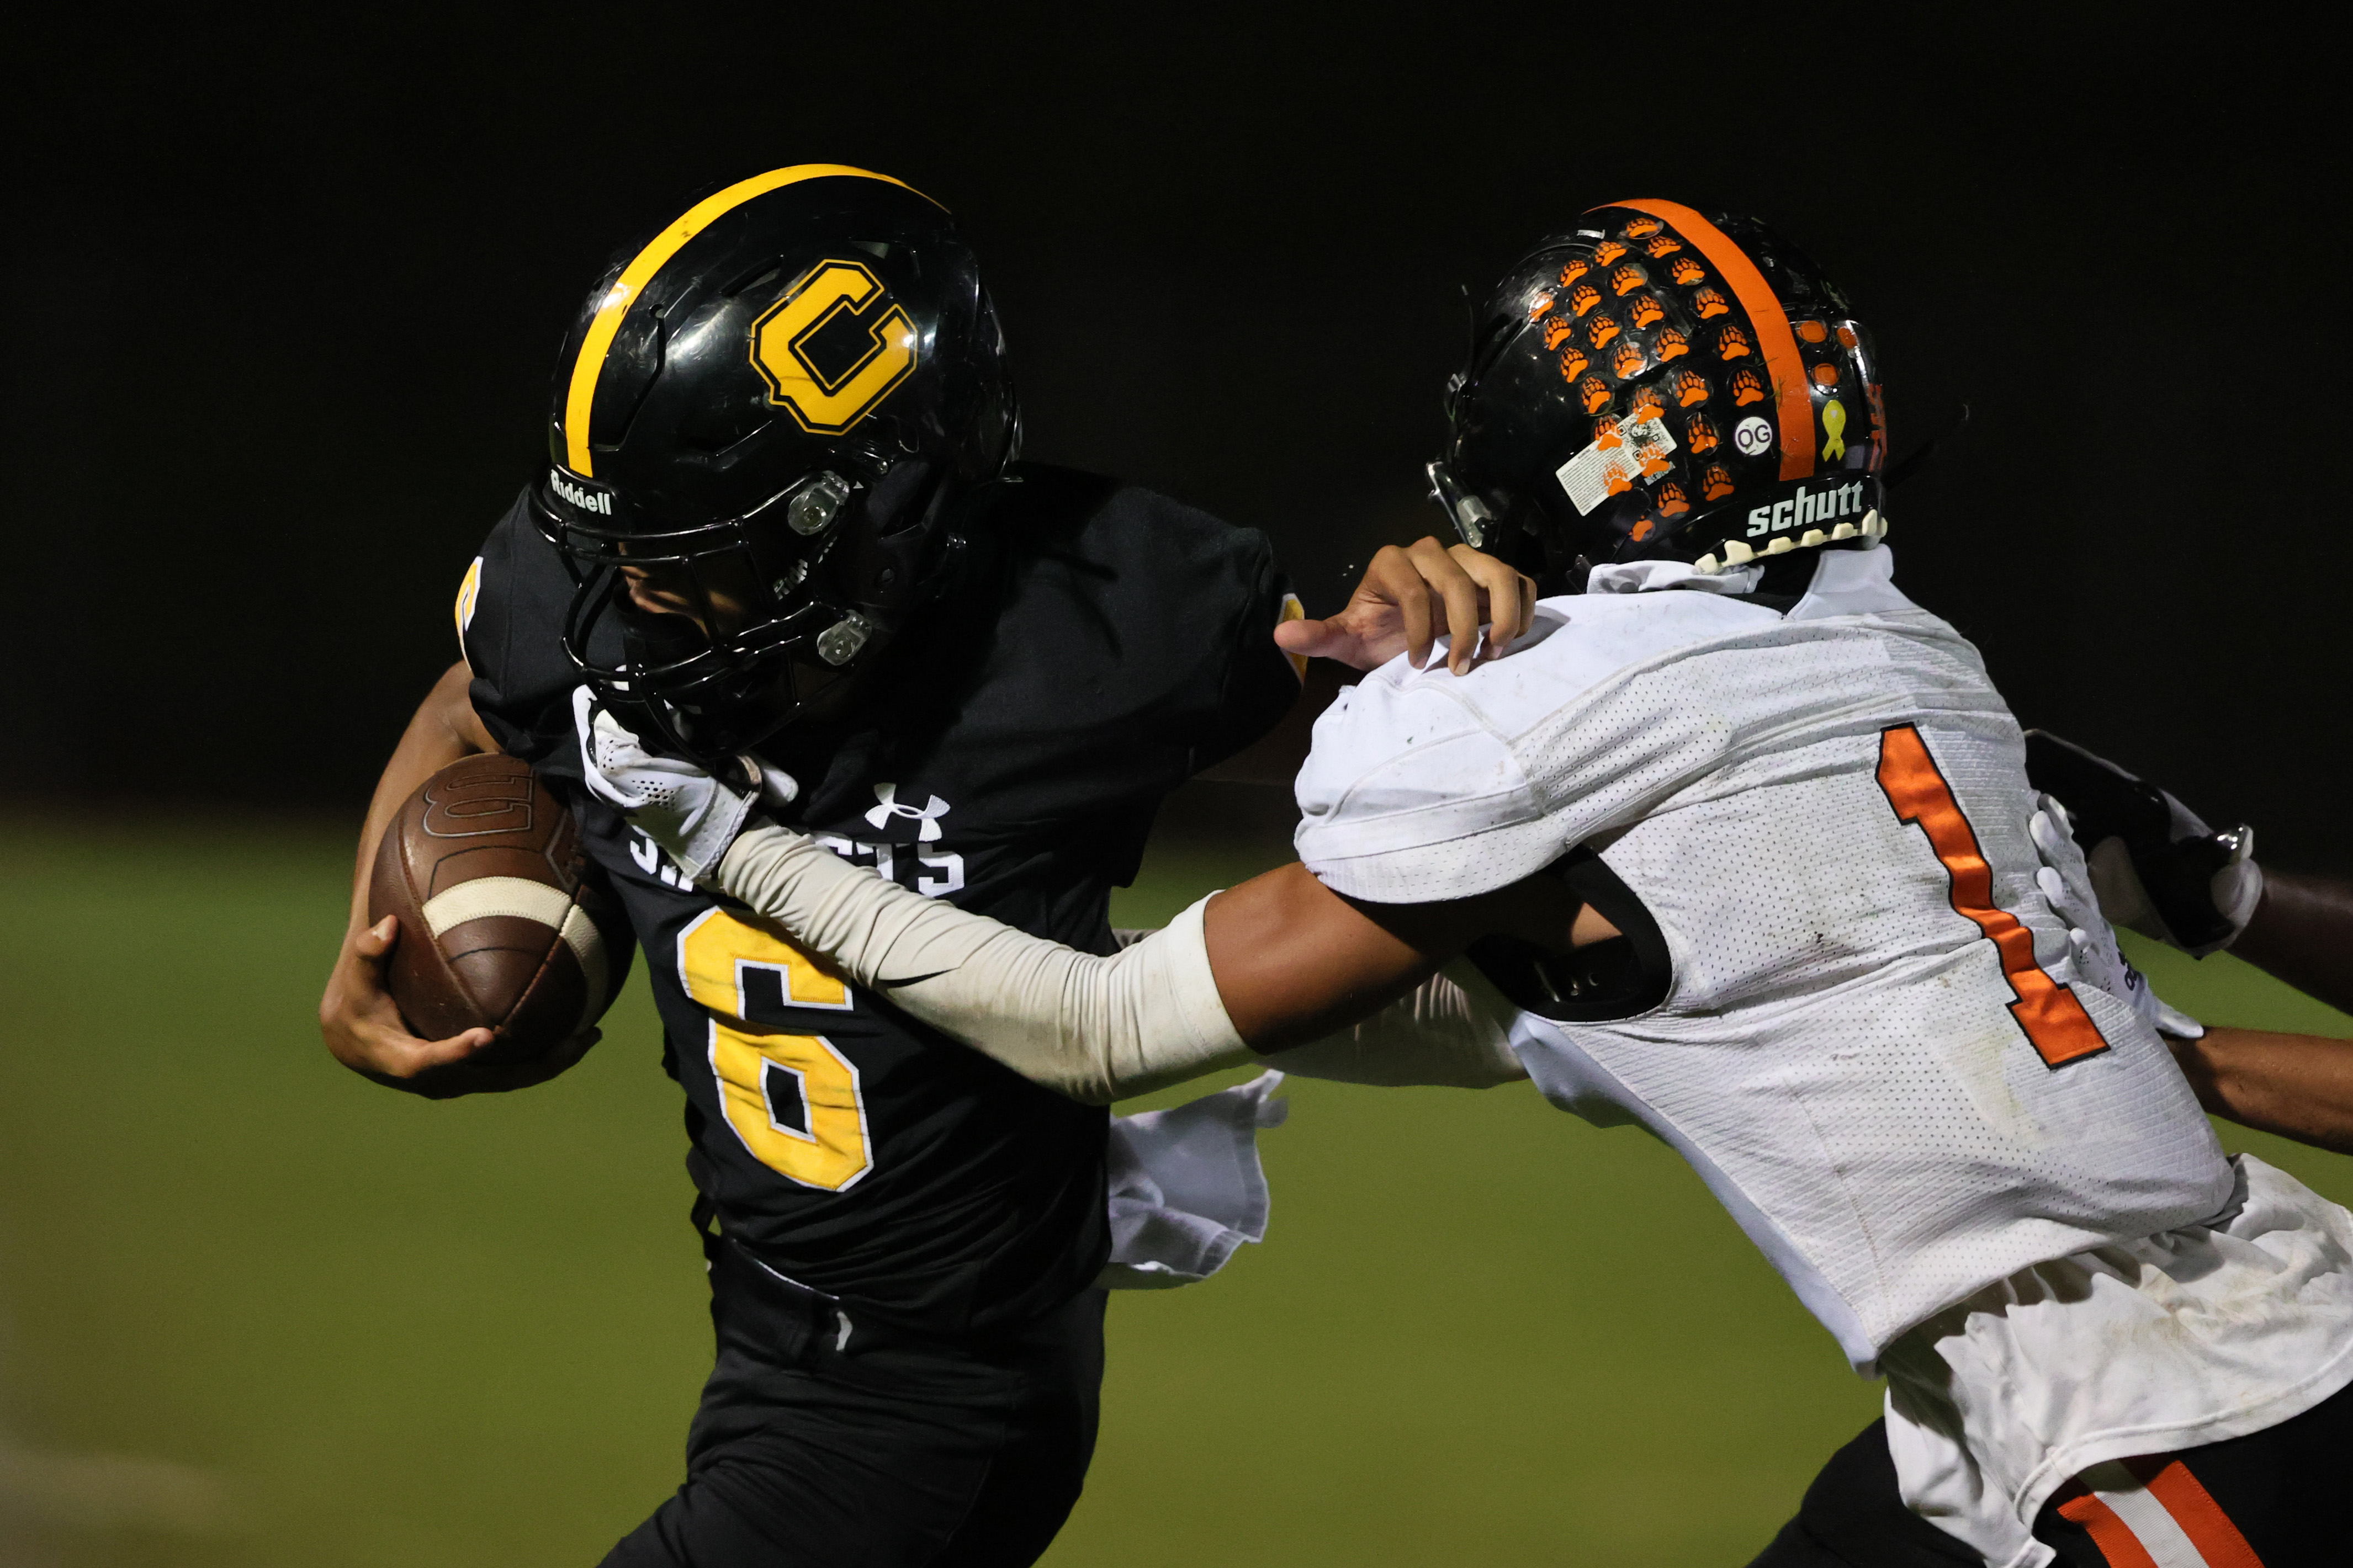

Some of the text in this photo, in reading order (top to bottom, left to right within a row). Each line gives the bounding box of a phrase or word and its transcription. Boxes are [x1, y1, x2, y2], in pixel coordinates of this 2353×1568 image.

[749, 258, 918, 436] C
[550, 469, 612, 515] Riddell
[1737, 424, 1771, 448] OG
[1746, 480, 1864, 538] schutt
[1874, 721, 2112, 1071] 1
[677, 905, 875, 1193] 6
